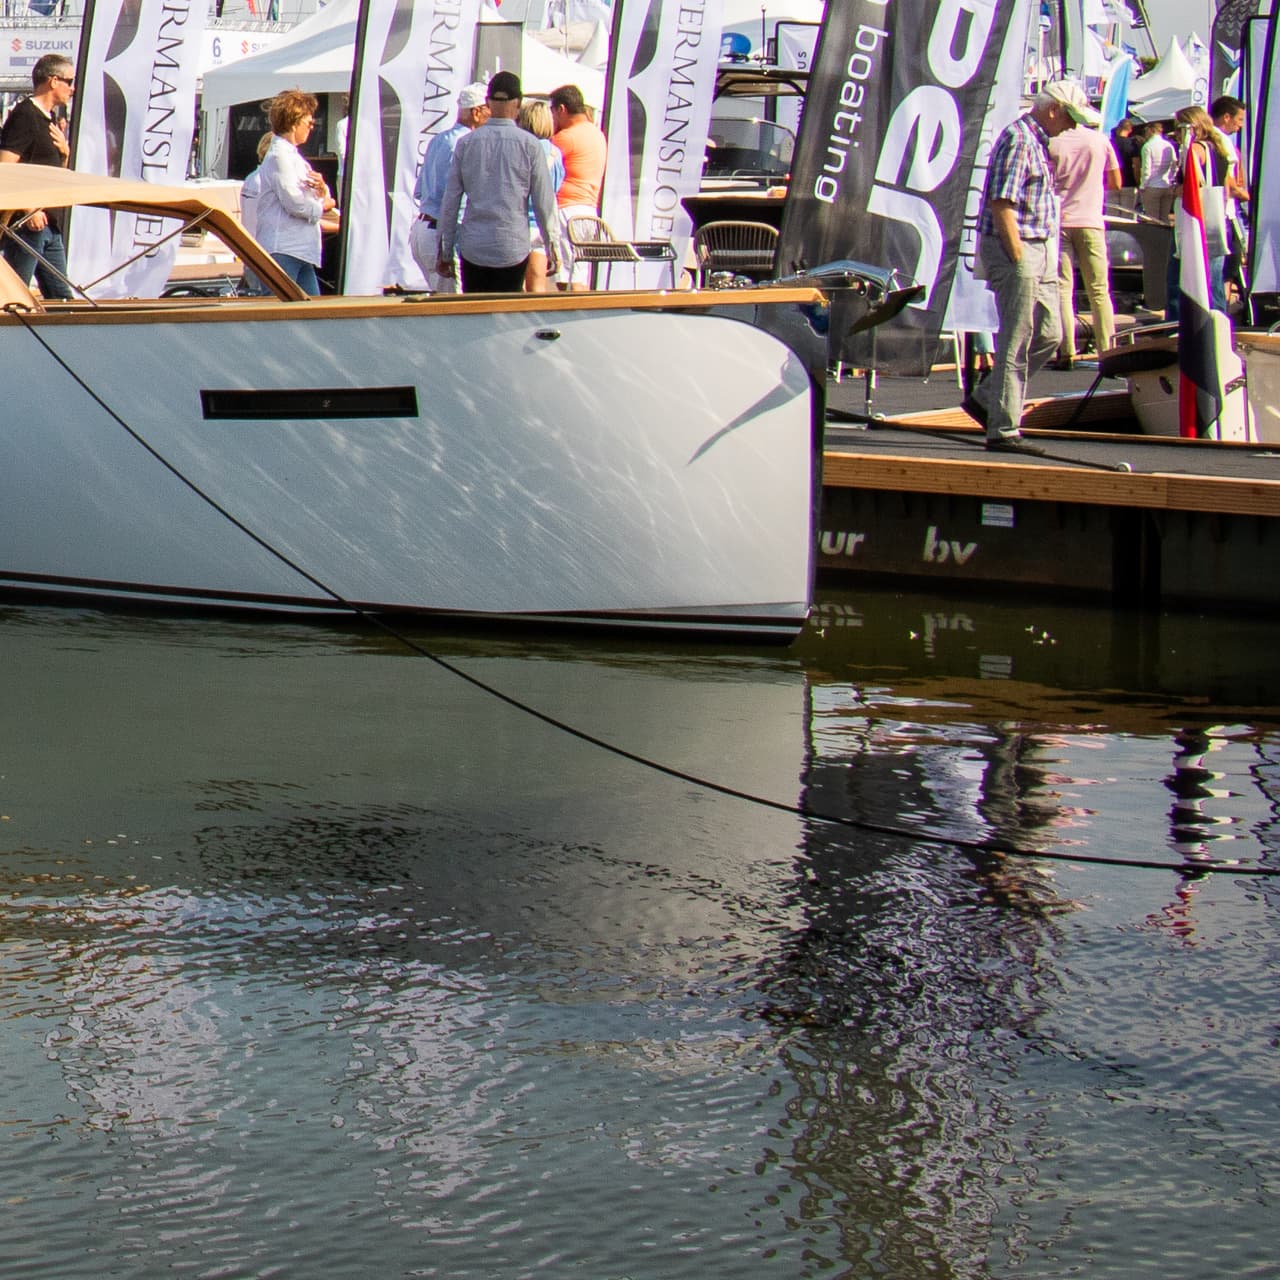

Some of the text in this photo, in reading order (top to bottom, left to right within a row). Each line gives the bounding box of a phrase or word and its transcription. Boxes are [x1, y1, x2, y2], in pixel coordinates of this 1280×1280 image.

[25, 40, 74, 51] SUZUKI
[813, 23, 890, 205] boating
[923, 526, 977, 566] bv
